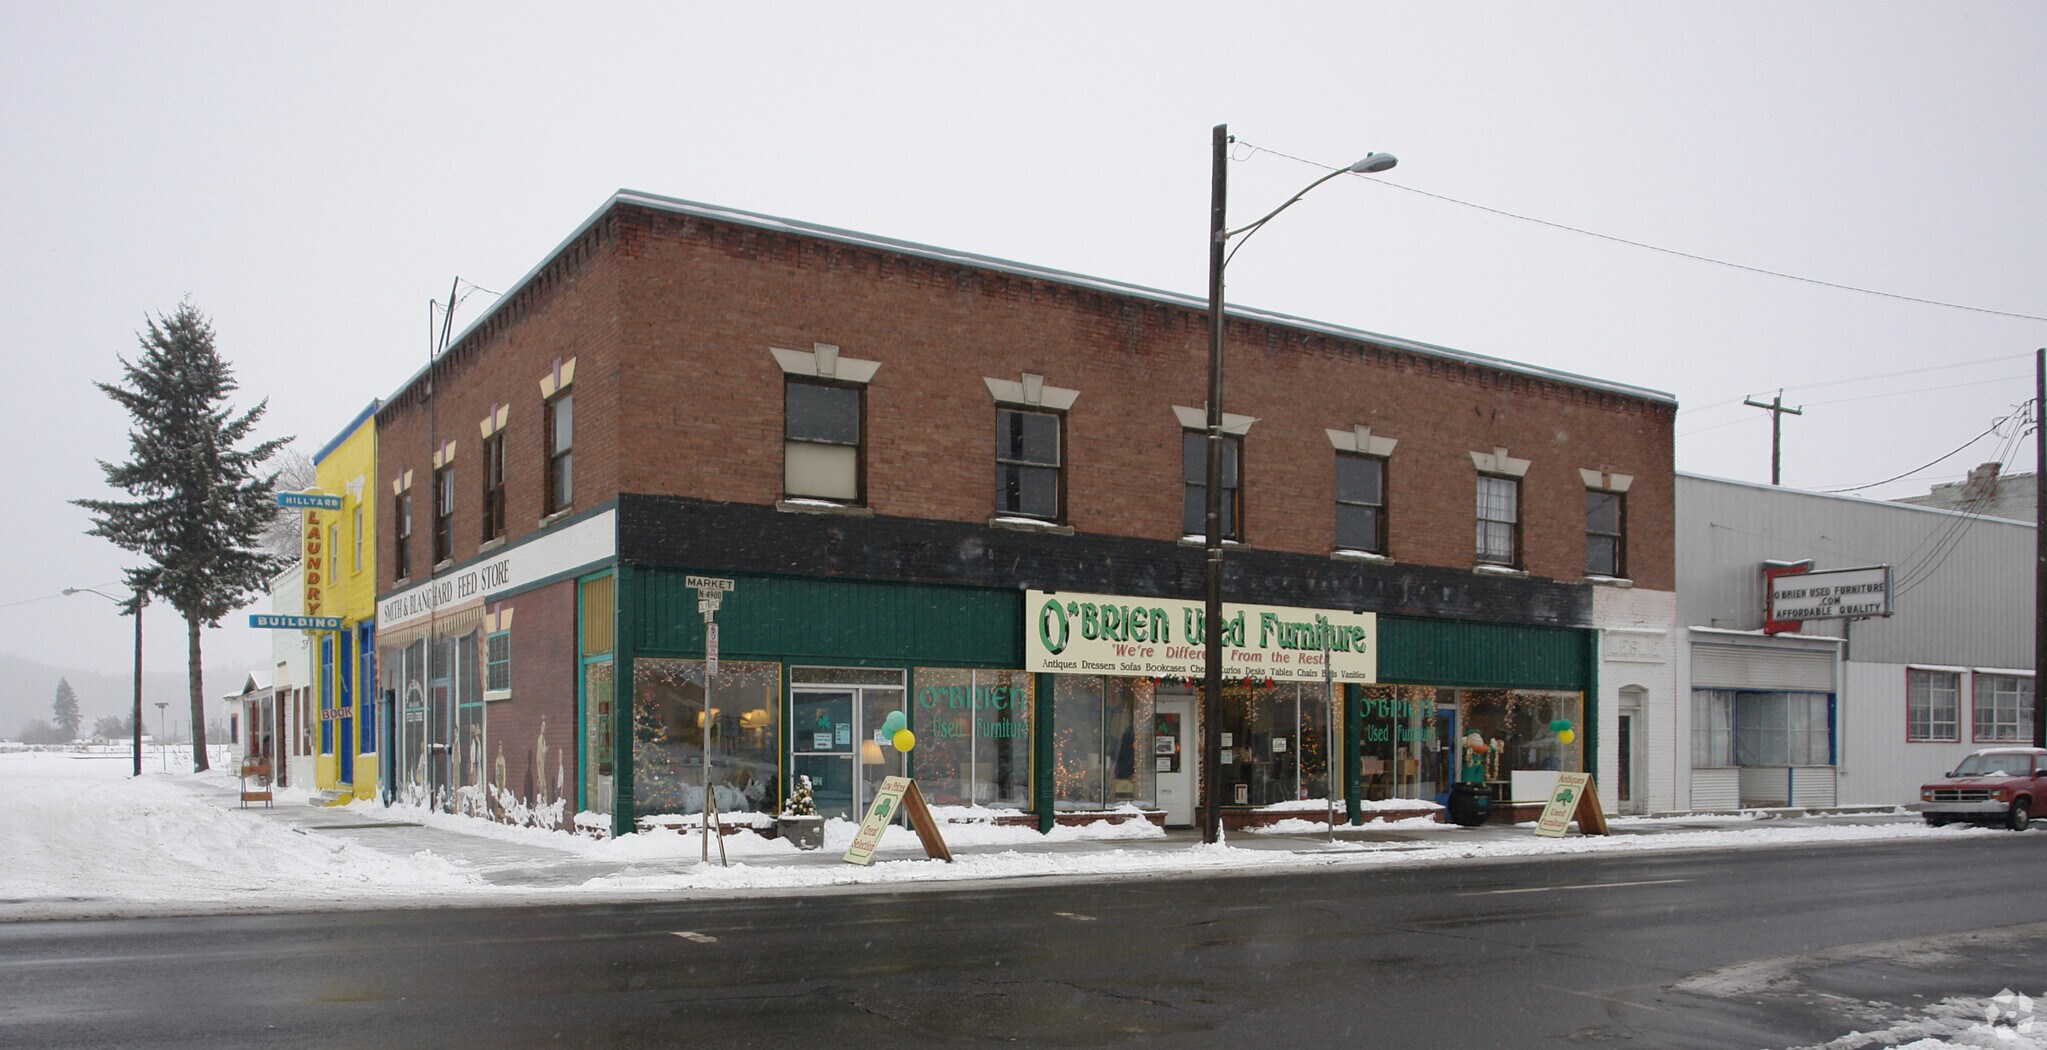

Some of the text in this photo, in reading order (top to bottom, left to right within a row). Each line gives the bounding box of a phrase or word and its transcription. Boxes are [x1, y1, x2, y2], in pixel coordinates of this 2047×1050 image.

[286, 496, 338, 508] HILLYARD
[307, 510, 320, 616] LAUNDRY
[384, 559, 510, 623] SMITH & BLANCHARD FEED STORE
[687, 578, 733, 590] MARKET
[1810, 587, 1830, 598] USED
[1834, 582, 1885, 595] FURNITURE
[700, 590, 721, 600] N 4900
[1818, 596, 1840, 606] .COM
[1776, 603, 1881, 618] AFFORDABLE QUALITY
[257, 616, 337, 628] BUILDING
[1259, 612, 1366, 654] Furniture
[1166, 646, 1206, 660] Differe
[1230, 650, 1262, 662] From
[1271, 652, 1290, 663] the
[1043, 659, 1077, 670] Antiques
[1082, 660, 1116, 670] Dressers
[1120, 662, 1141, 670] Sofas
[1146, 662, 1186, 672] Bookcases
[1222, 666, 1241, 674] urios
[1246, 666, 1266, 676] Desks
[1270, 668, 1293, 676] Tables
[1296, 668, 1318, 677] Chairs
[1341, 670, 1366, 678] Vanities
[322, 707, 352, 720] BOOK
[932, 716, 1029, 738] Used Furniture
[1368, 724, 1389, 742] Used
